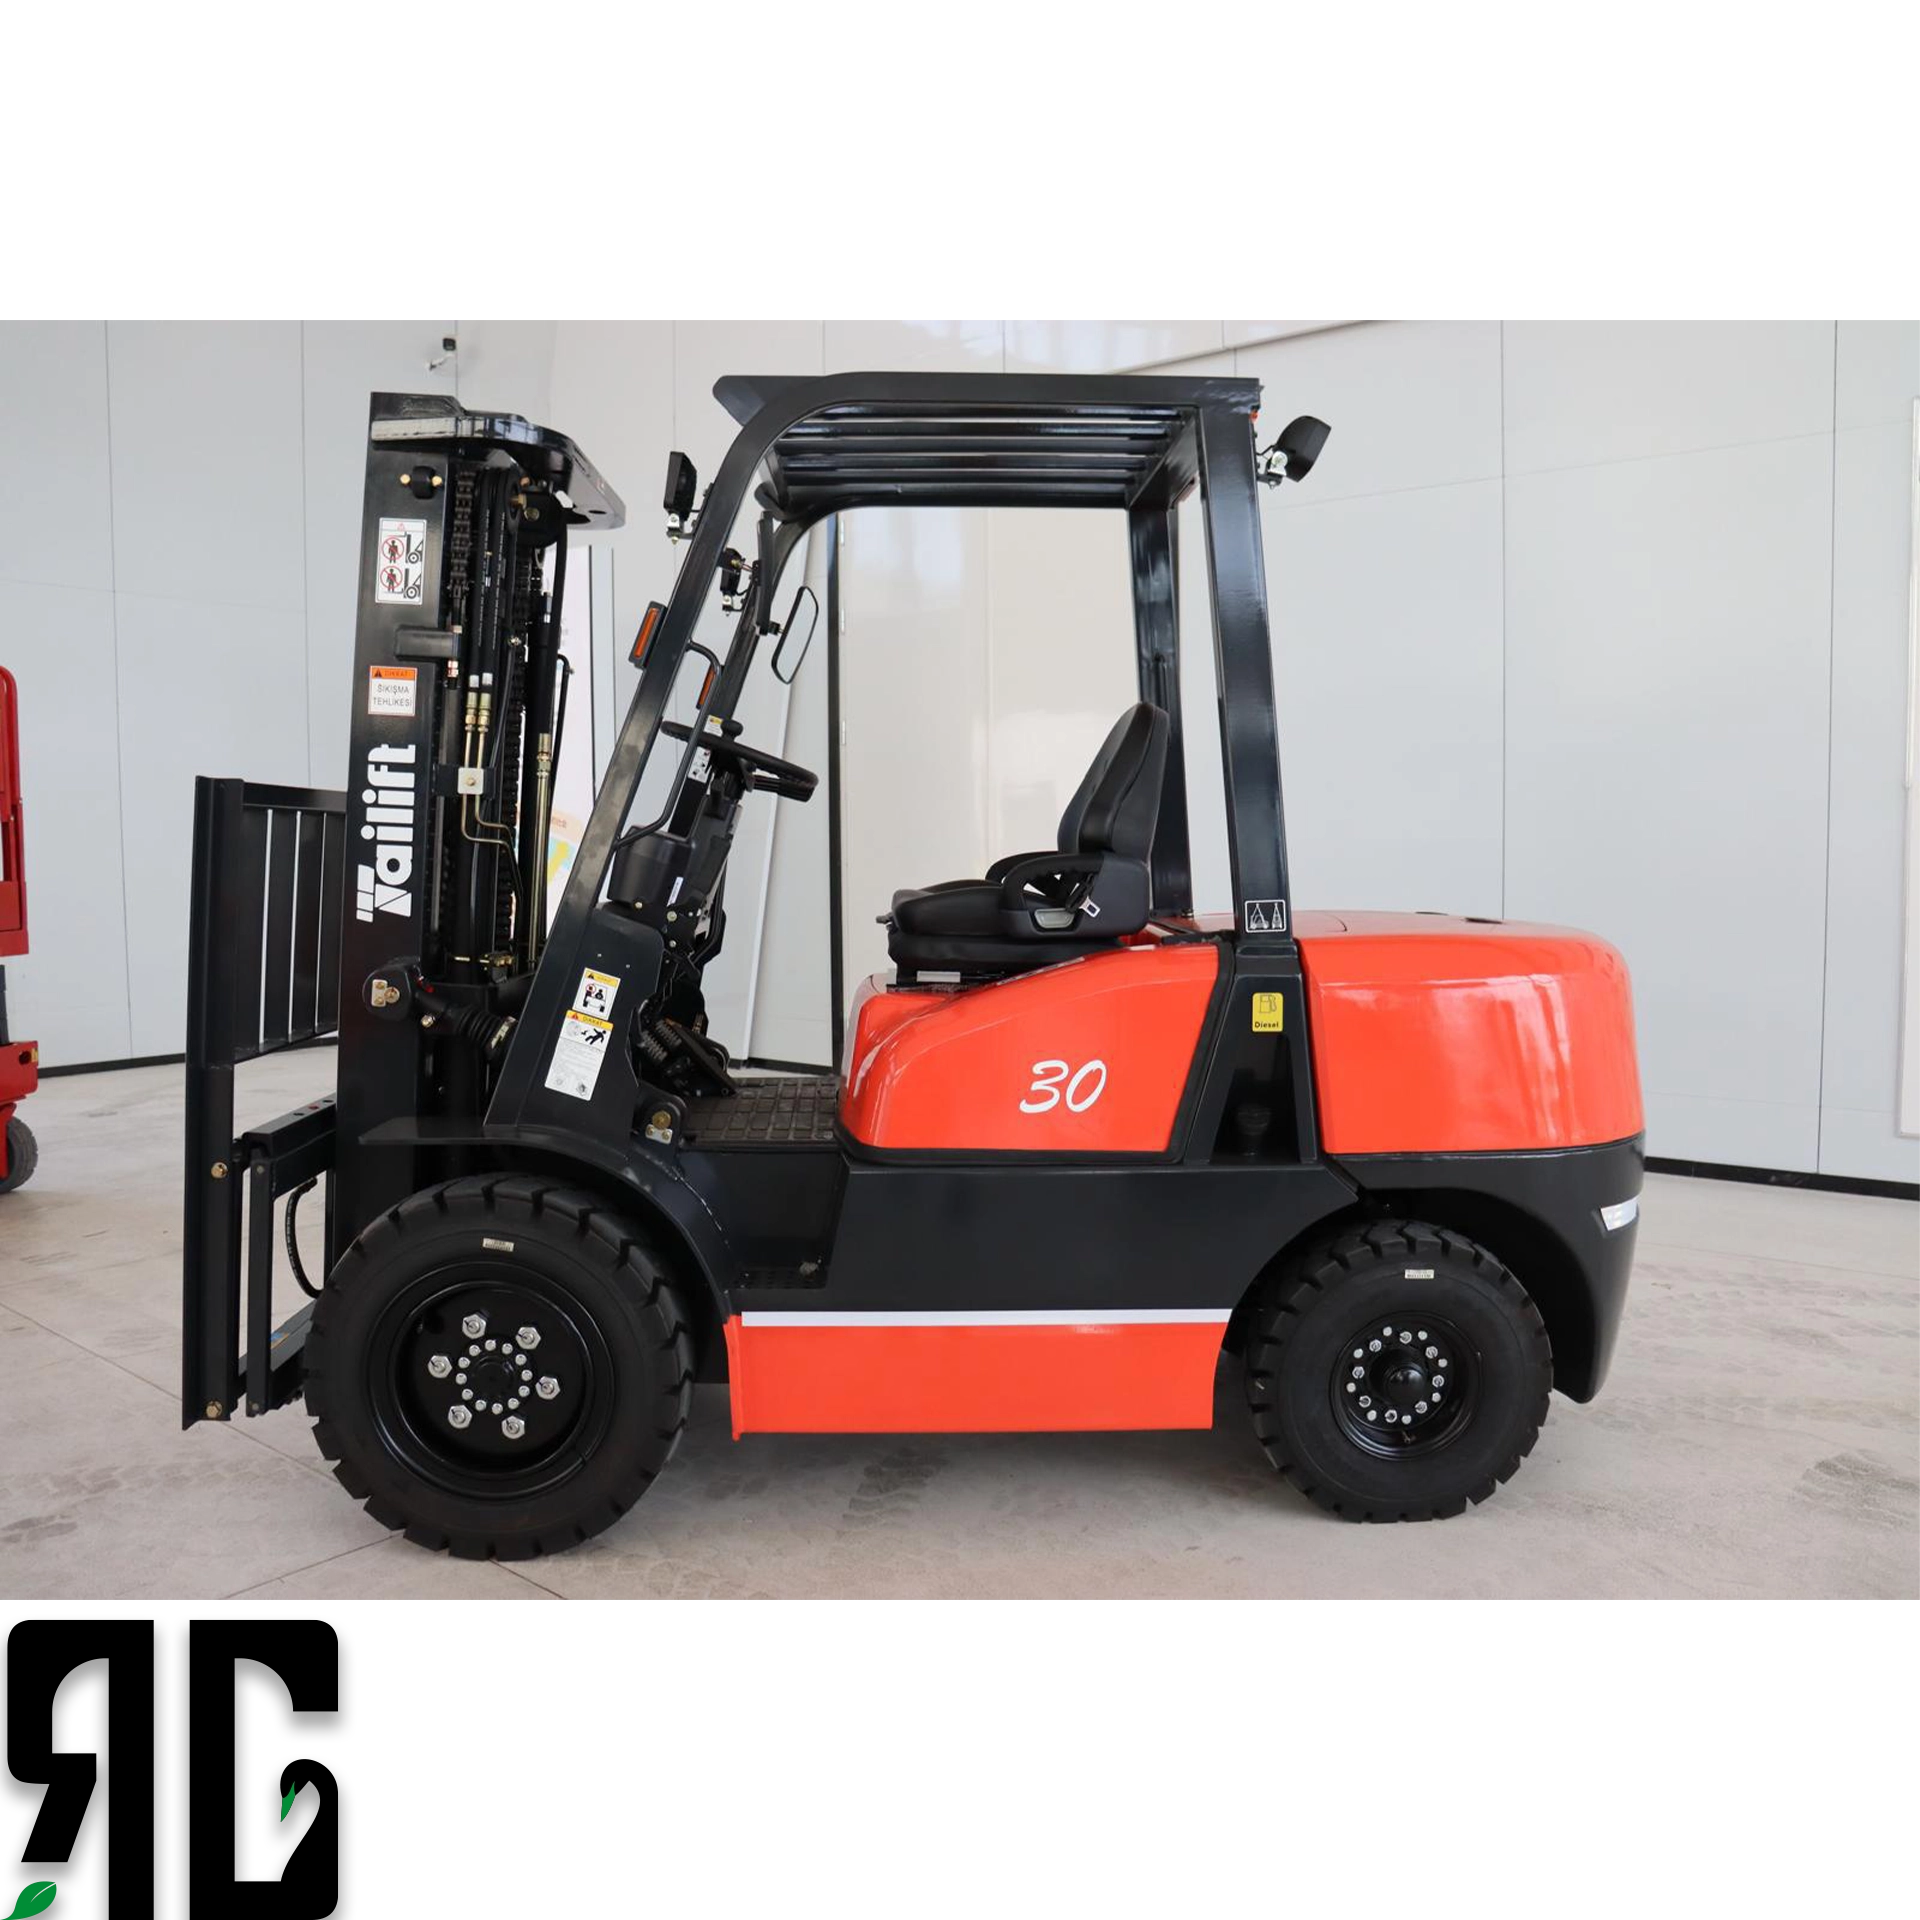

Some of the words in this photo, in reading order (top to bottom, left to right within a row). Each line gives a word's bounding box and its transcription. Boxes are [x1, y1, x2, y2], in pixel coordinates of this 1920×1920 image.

[356, 743, 416, 923] Tailift
[1254, 1021, 1279, 1029] Diesel
[1019, 1059, 1107, 1114] 30
